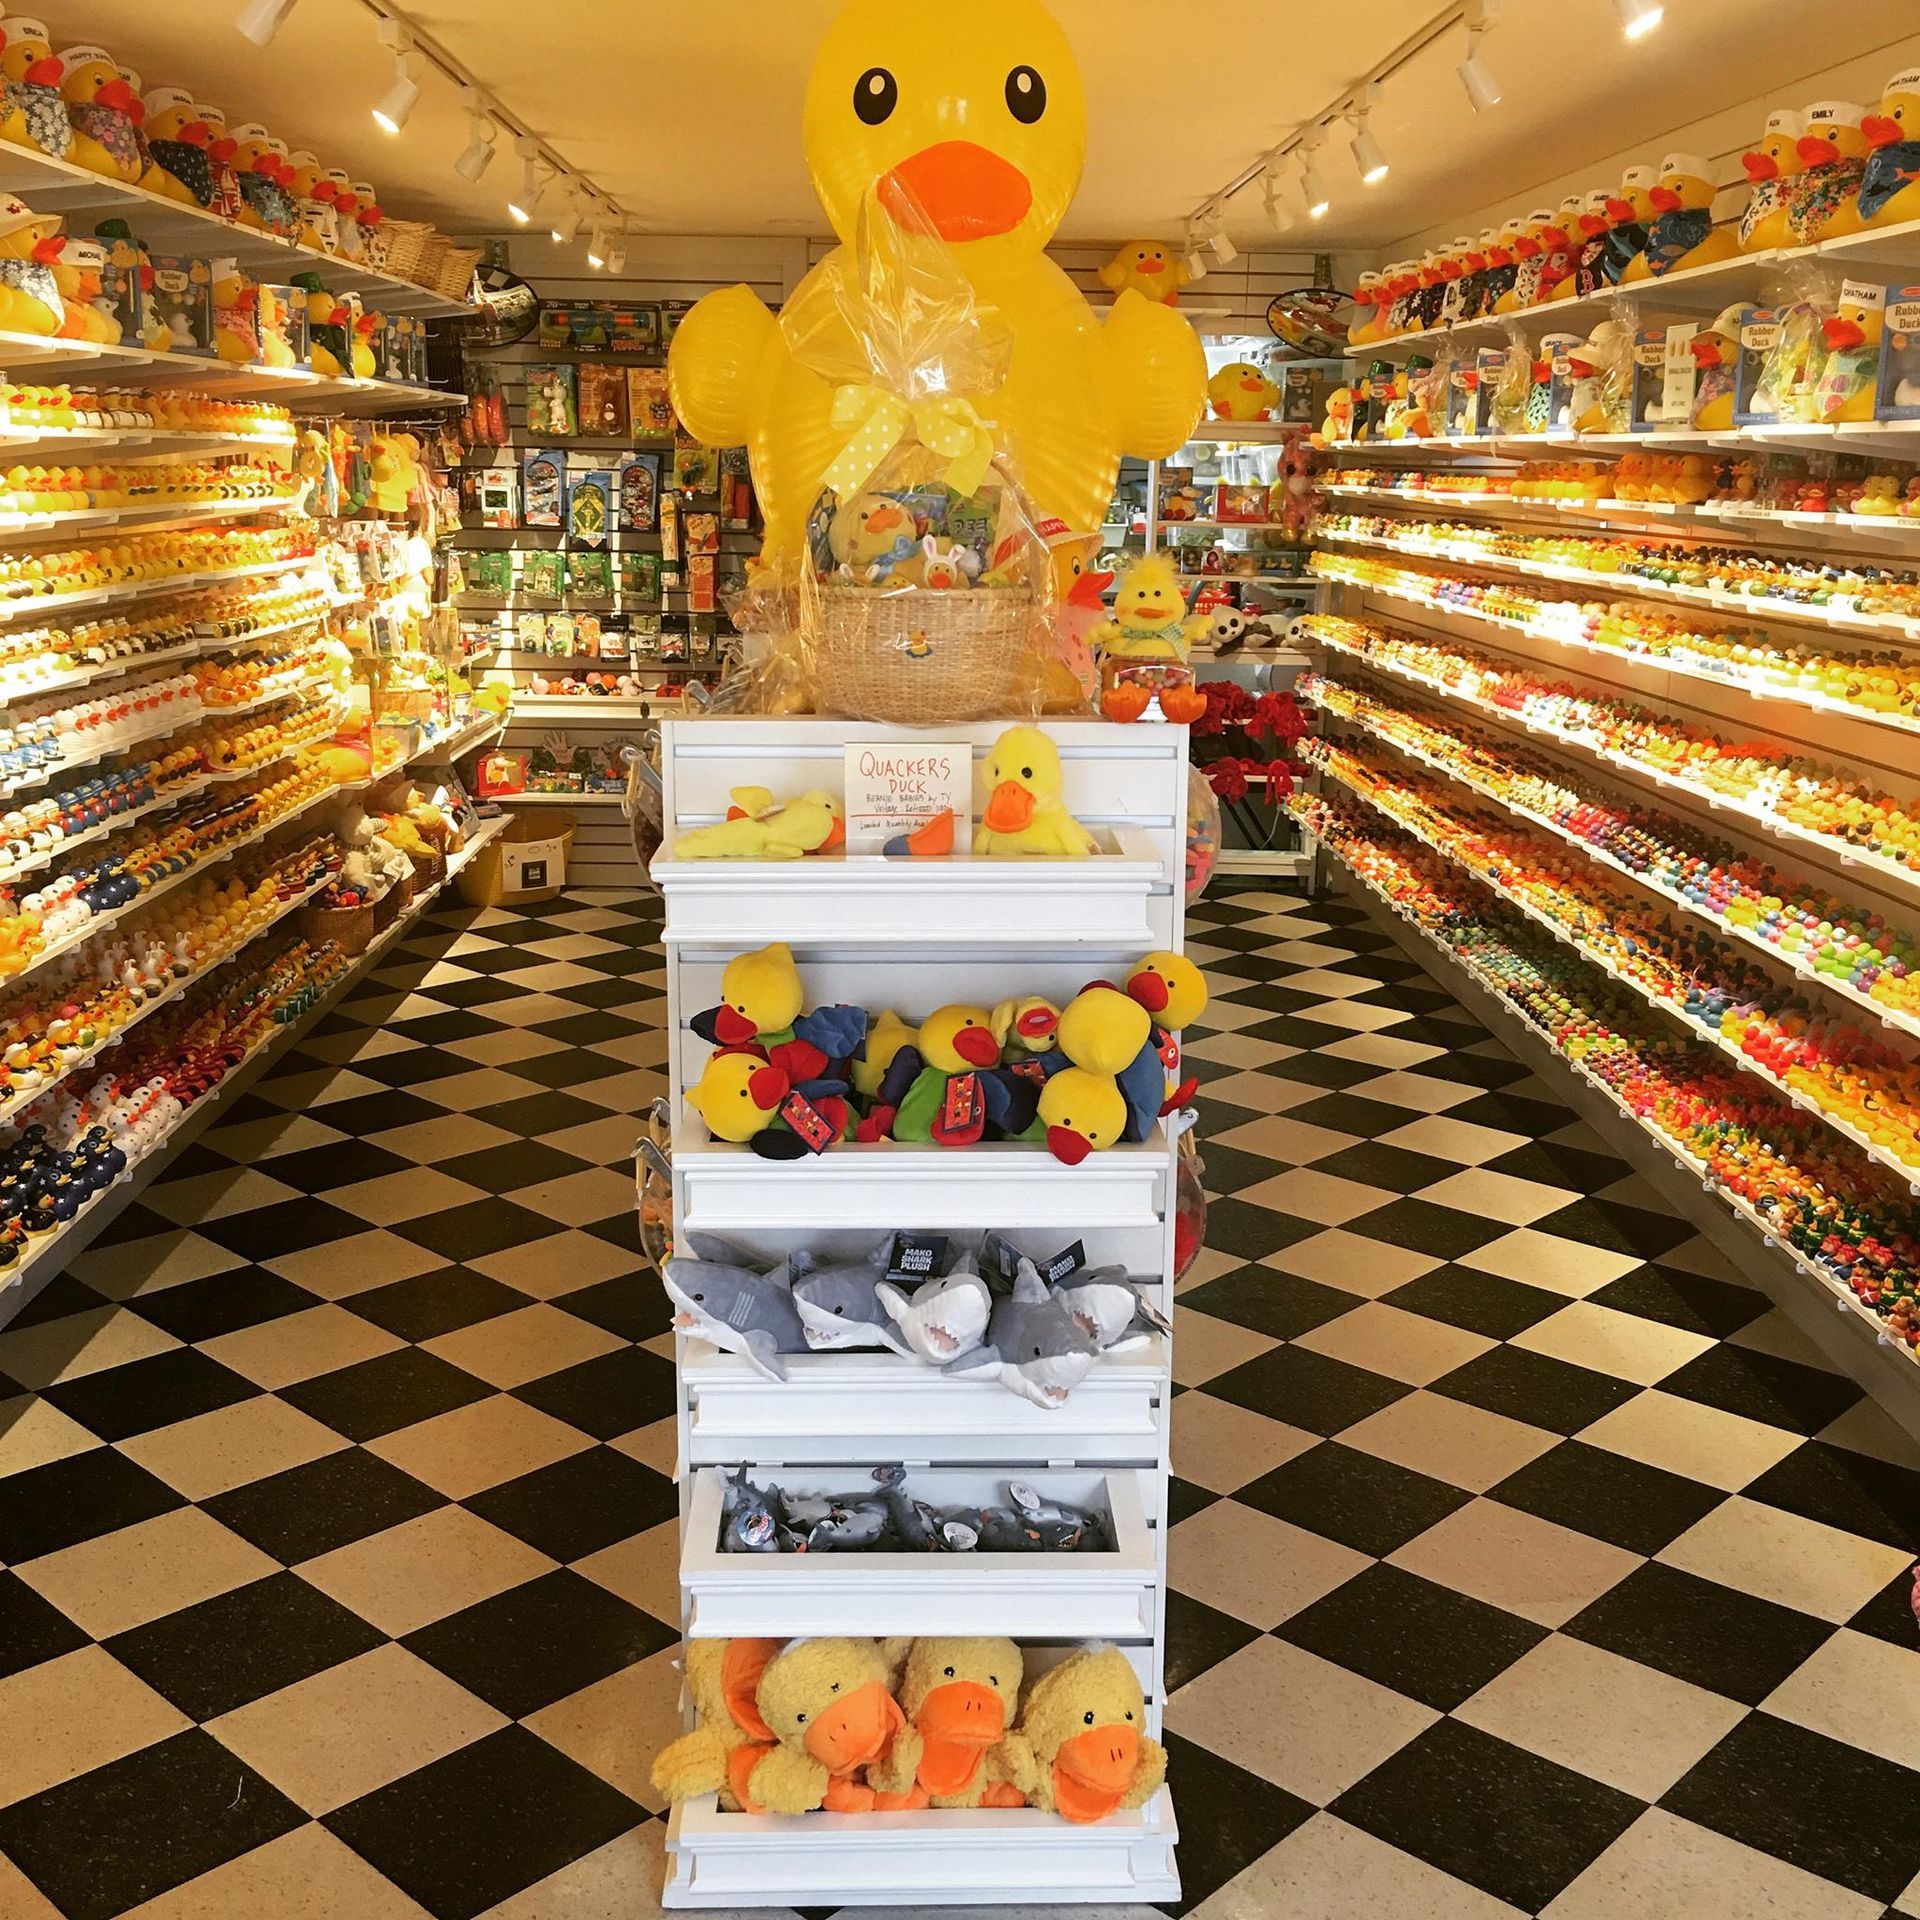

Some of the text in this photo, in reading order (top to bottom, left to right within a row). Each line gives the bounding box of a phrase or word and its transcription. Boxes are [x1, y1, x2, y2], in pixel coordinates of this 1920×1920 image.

[1811, 109, 1835, 120] EMILY
[1843, 288, 1877, 301] CHATHAM
[1895, 304, 1920, 317] Rubb
[1748, 326, 1776, 338] Rubber
[1751, 337, 1770, 348] Duck
[1644, 354, 1661, 364] Duck
[860, 751, 951, 781] QUACKERS
[889, 779, 927, 794] DUCK
[905, 1248, 933, 1257] MAKO
[901, 1254, 934, 1265] SHARK
[900, 1262, 931, 1271] PLUSH
